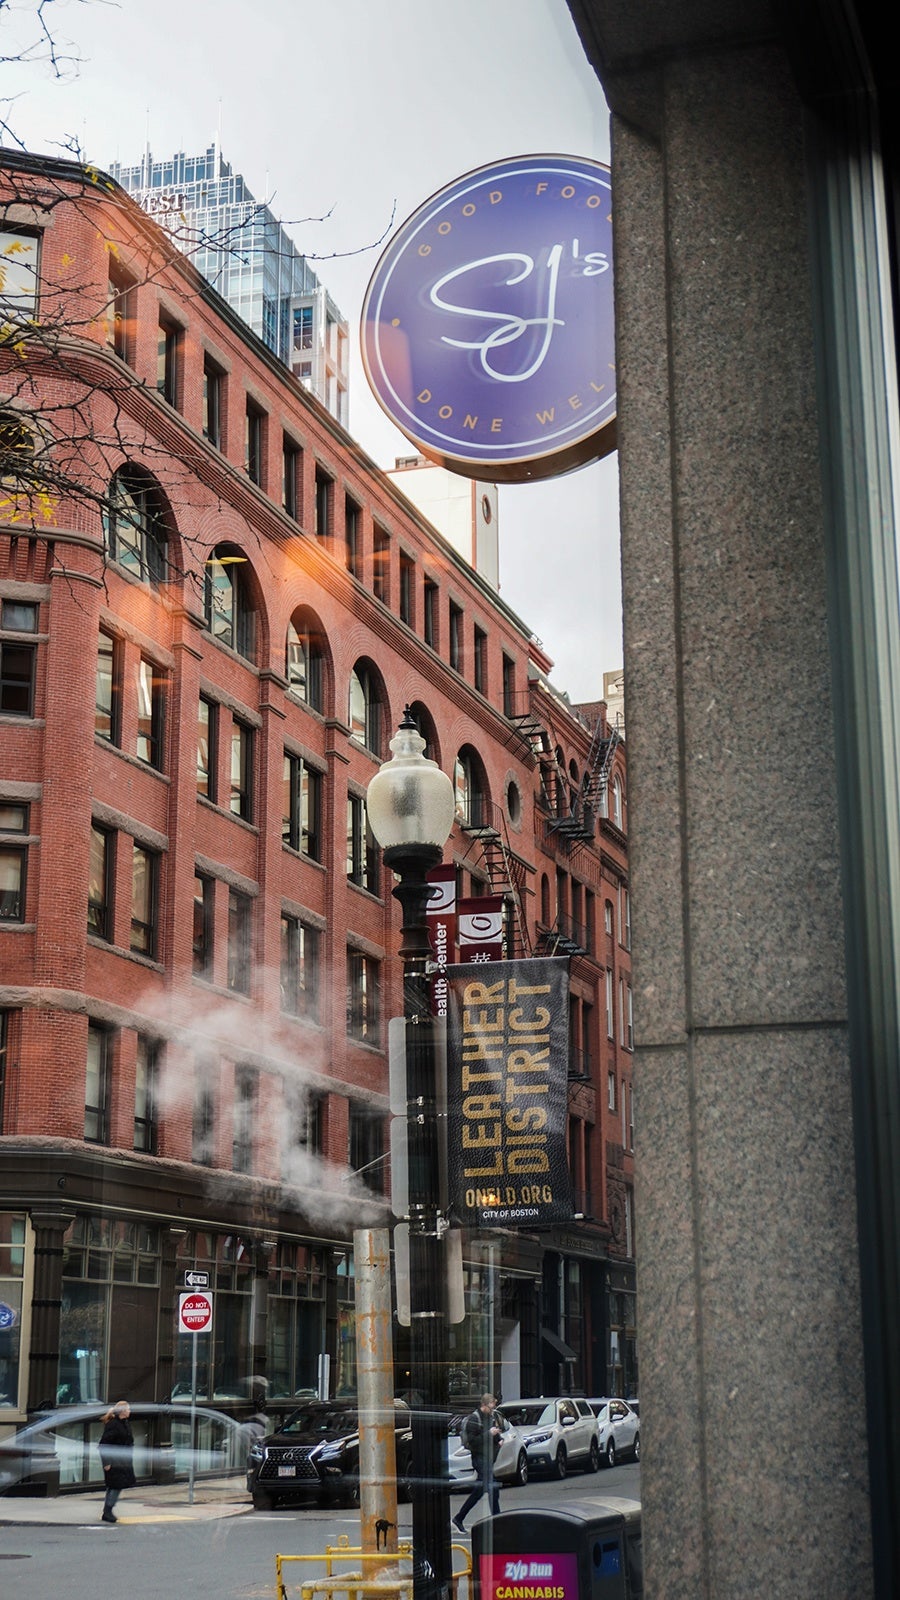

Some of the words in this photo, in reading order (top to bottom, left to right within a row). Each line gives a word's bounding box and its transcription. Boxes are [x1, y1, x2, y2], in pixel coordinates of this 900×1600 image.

[418, 191, 503, 257] GOOD
[536, 182, 612, 224] FOO
[417, 388, 503, 432] DONE
[434, 978, 447, 1017] ealth
[461, 979, 506, 1178] LEATHER
[505, 978, 551, 1175] DISTRICT
[482, 1210, 499, 1219] CITY
[499, 1210, 510, 1218] OF
[510, 1208, 539, 1217] BOSTON
[529, 1562, 554, 1577] Run
[495, 1586, 565, 1599] CANNABIS
